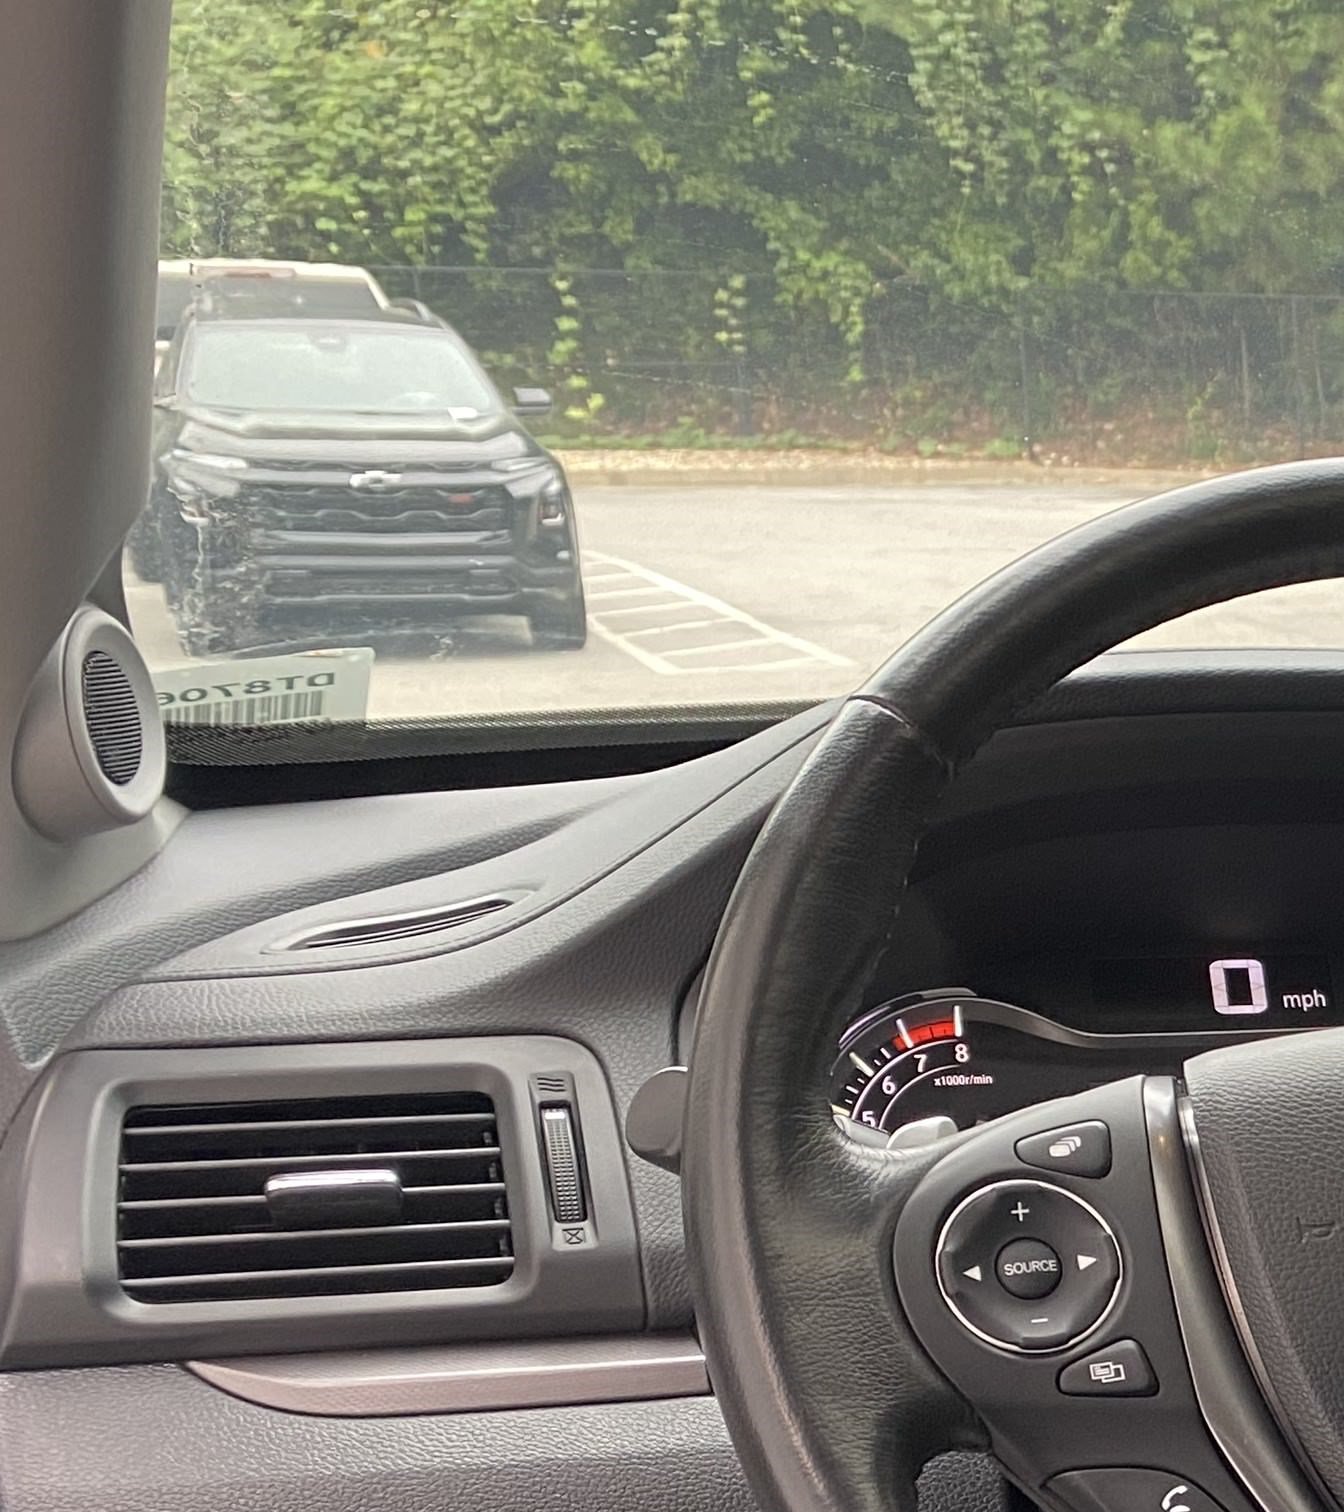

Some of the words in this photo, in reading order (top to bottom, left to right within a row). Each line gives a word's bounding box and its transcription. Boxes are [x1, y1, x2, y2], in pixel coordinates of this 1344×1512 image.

[1209, 958, 1268, 1015] 0
[1282, 989, 1326, 1011] mph
[954, 1043, 969, 1063] 8
[913, 1054, 928, 1073] 7
[881, 1075, 896, 1095] 6
[934, 1074, 993, 1086] x1000r/min
[1004, 1257, 1057, 1276] SOURCE
